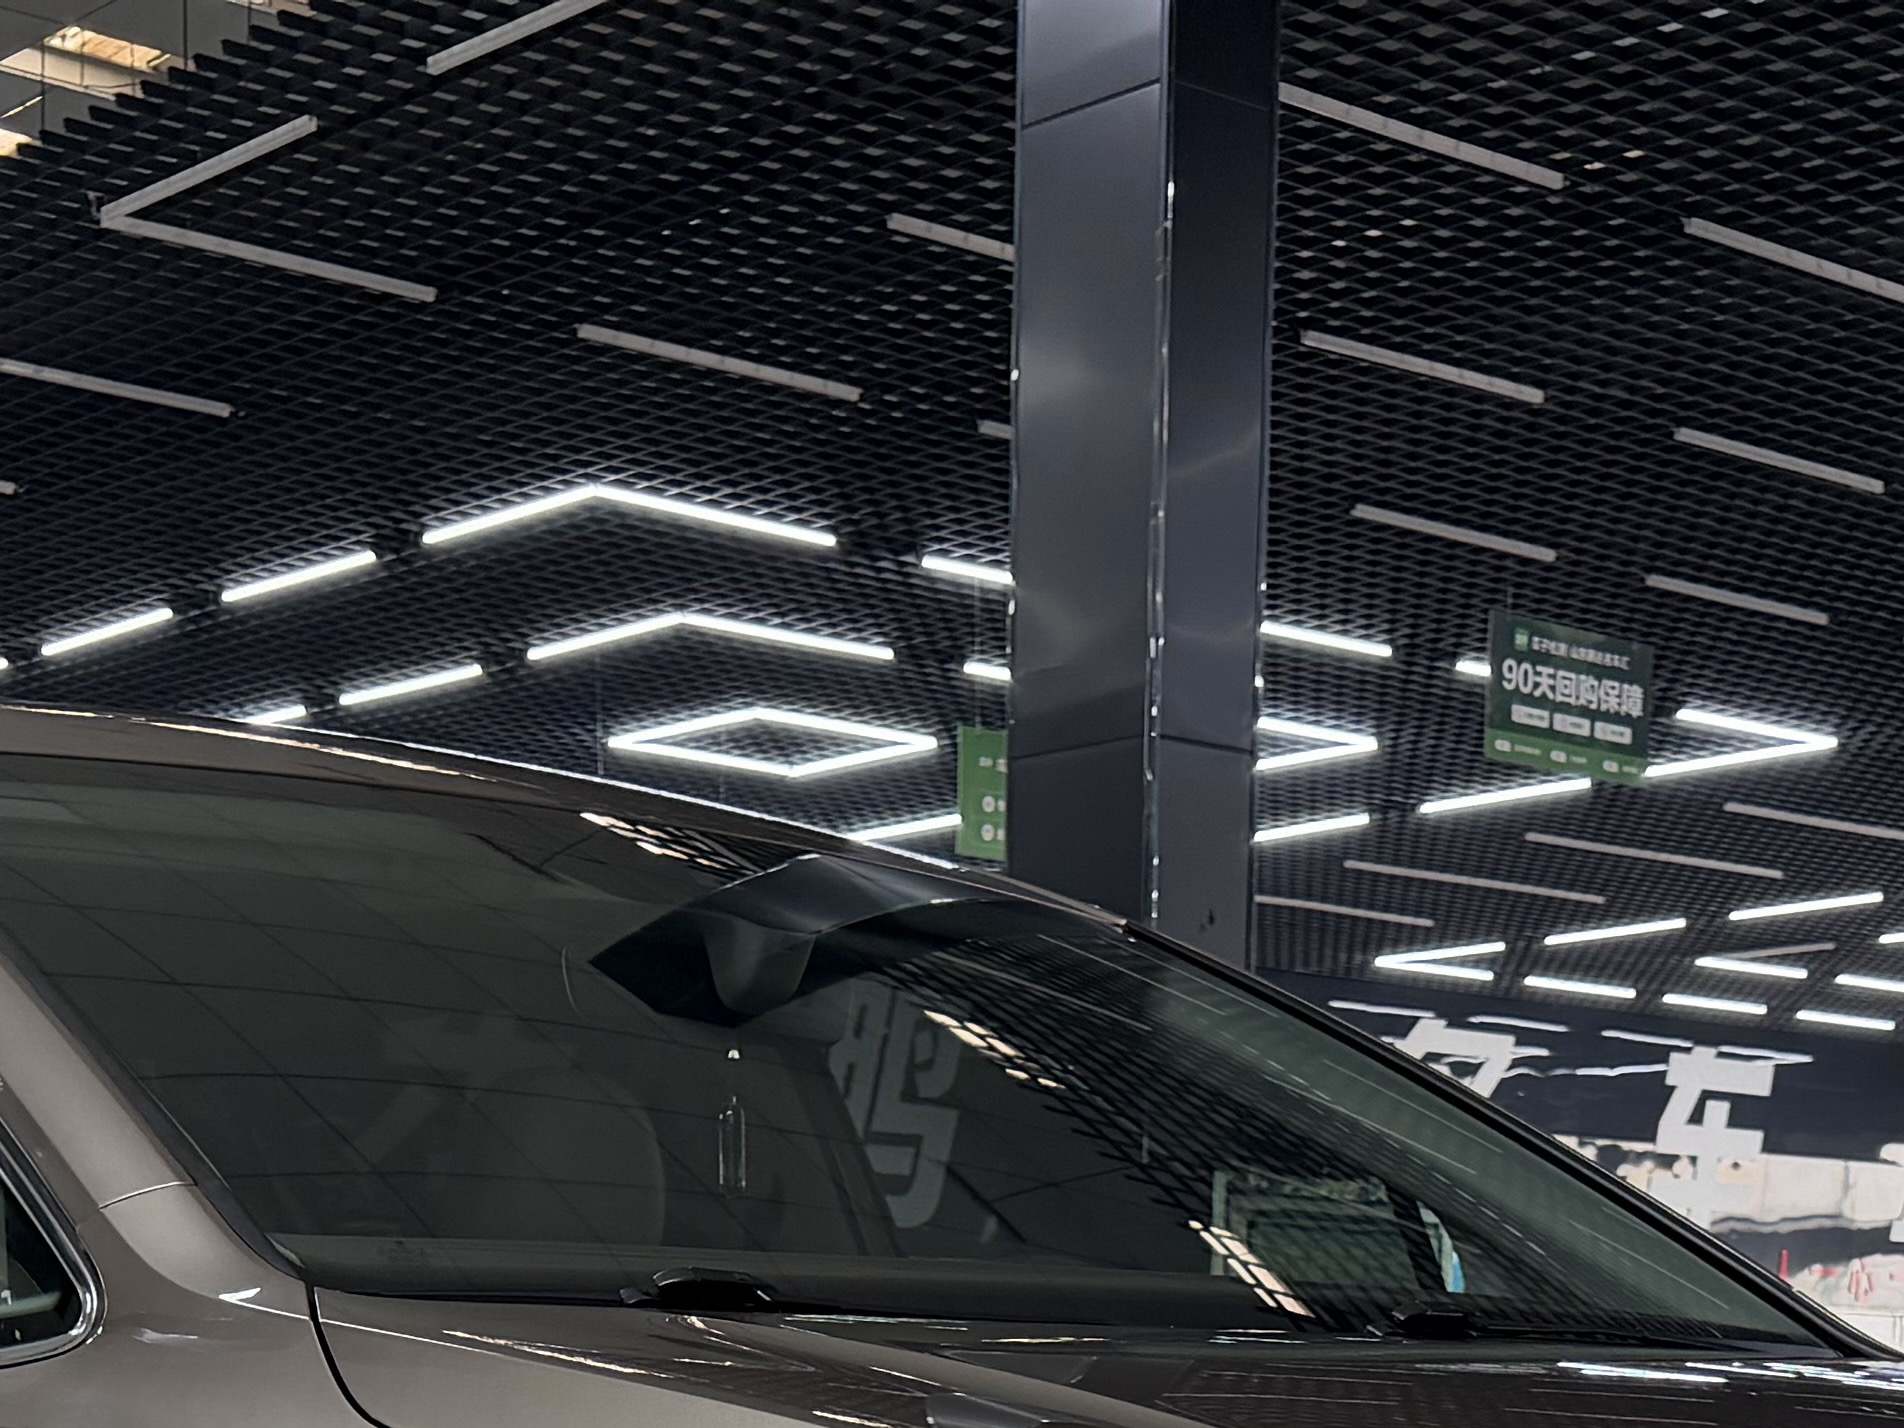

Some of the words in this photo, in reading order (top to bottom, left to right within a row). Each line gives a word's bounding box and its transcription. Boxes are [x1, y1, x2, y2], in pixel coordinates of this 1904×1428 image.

[1501, 657, 1646, 719] 90天回购保障
